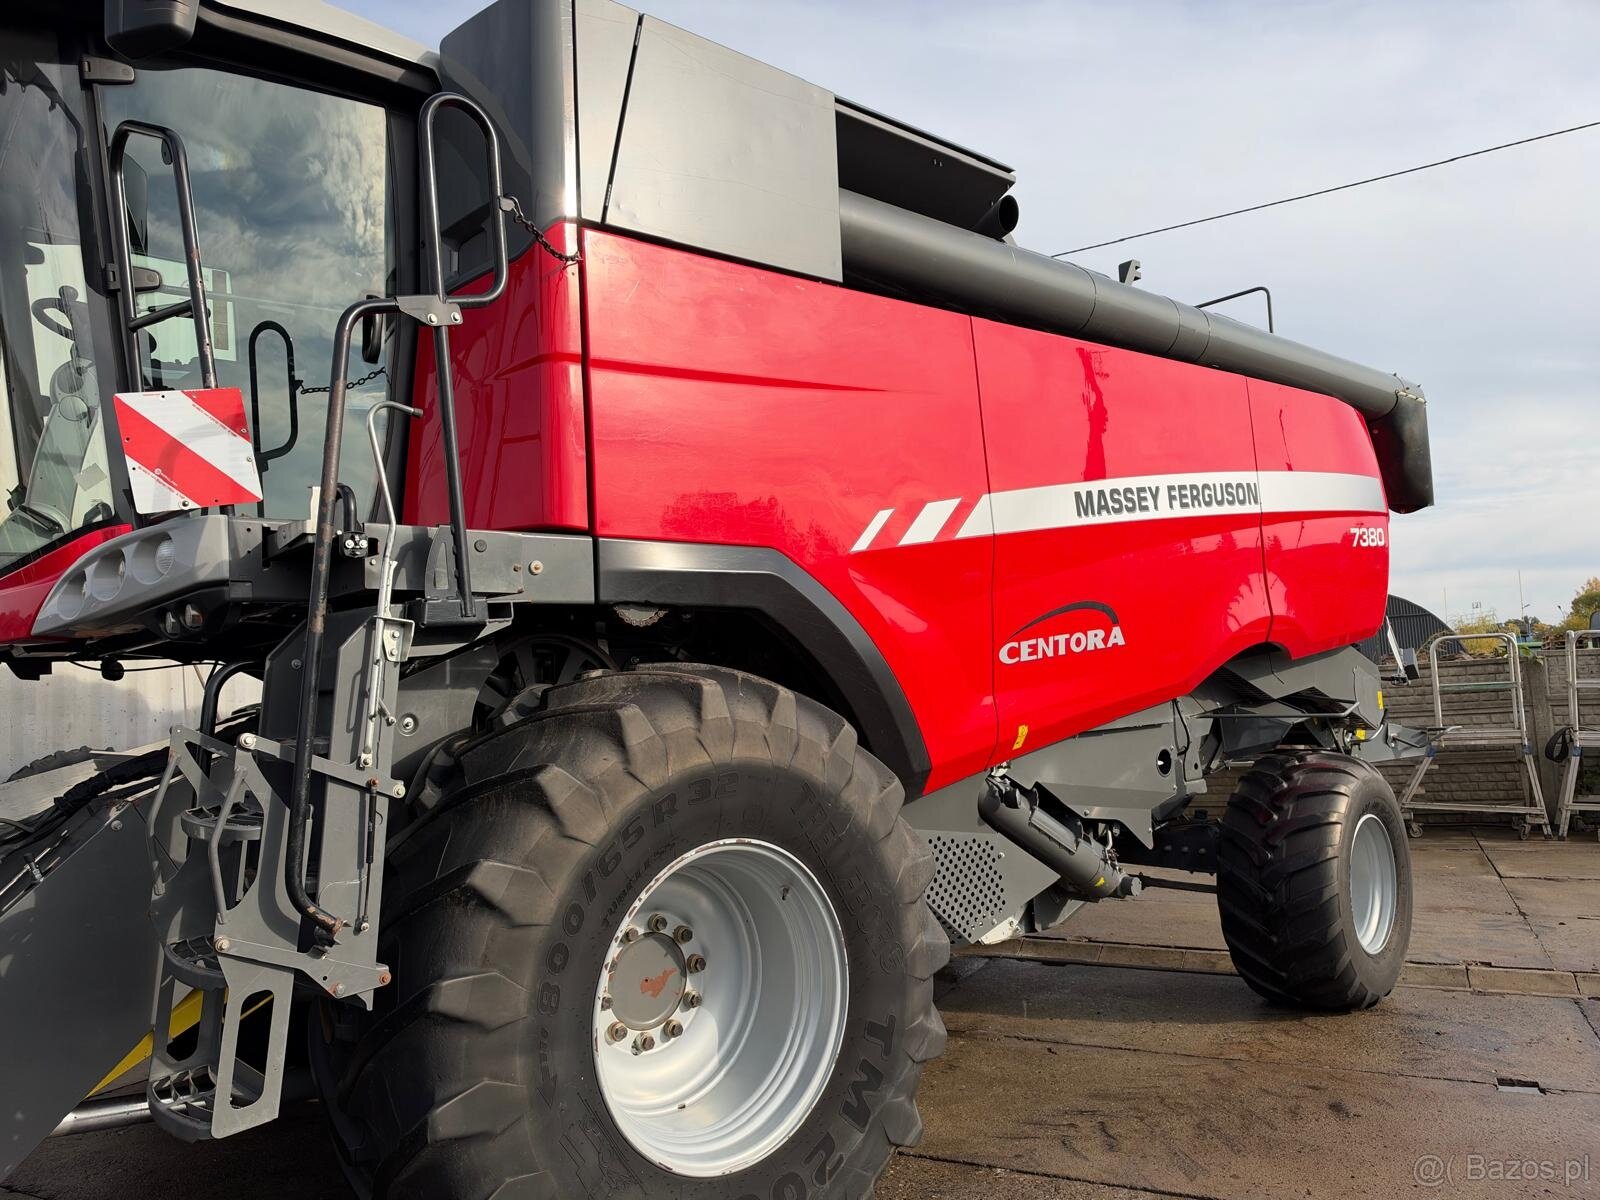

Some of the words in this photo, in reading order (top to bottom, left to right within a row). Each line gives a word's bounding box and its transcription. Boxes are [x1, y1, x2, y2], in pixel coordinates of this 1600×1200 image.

[1073, 485, 1160, 518] MASSEY
[1166, 482, 1260, 510] FERGUSON
[1350, 527, 1385, 548] 7380
[998, 625, 1126, 665] CENTORA
[537, 815, 646, 1016] 800/65
[652, 792, 680, 836] R
[686, 770, 740, 807] 32
[839, 1013, 897, 1134] TM
